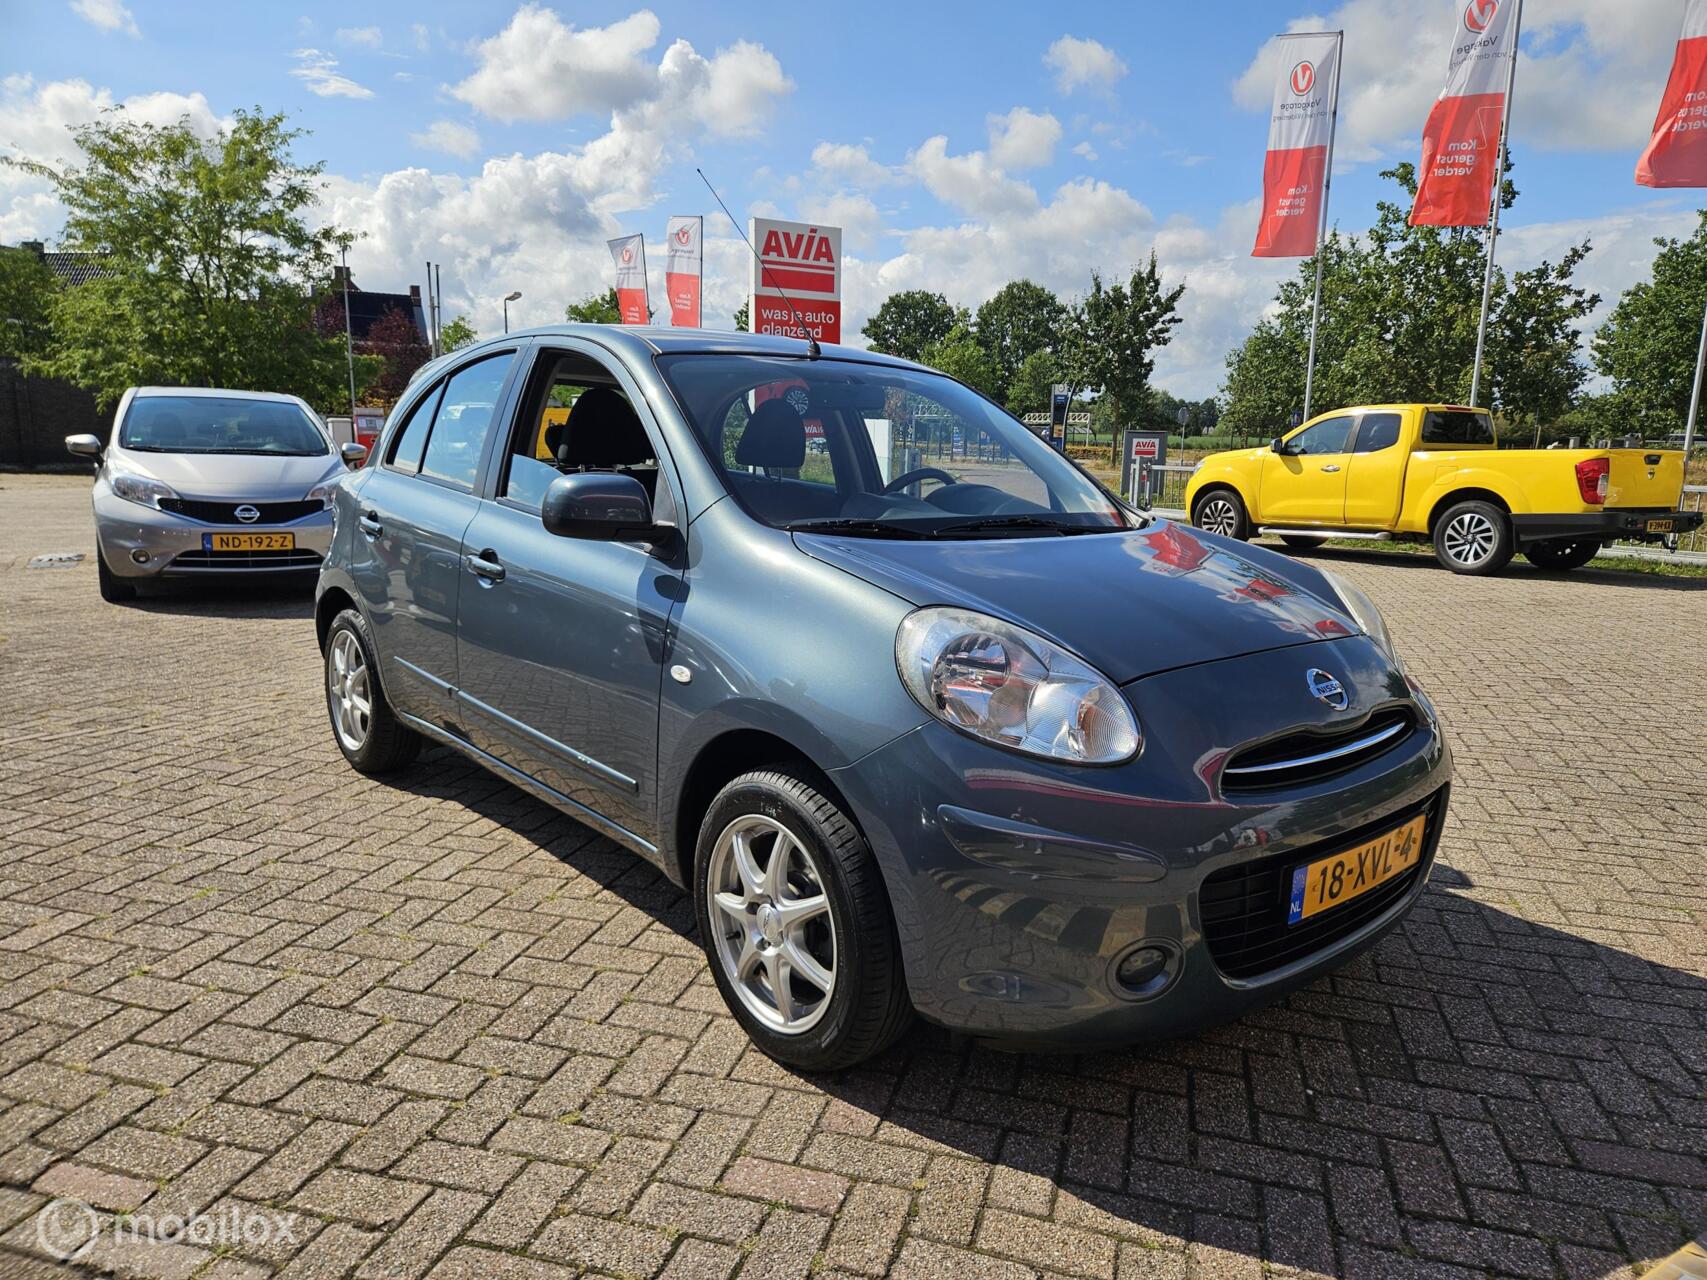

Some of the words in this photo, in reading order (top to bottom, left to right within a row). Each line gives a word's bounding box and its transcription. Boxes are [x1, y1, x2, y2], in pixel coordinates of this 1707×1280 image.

[762, 228, 835, 263] AVIA
[762, 309, 788, 320] was
[790, 310, 803, 324] je
[805, 311, 835, 323] auto
[762, 322, 822, 338] glanzend
[1135, 440, 1156, 448] AVIA
[220, 536, 288, 548] ND-192-Z
[1319, 827, 1413, 904] 18-XVL-4
[1290, 901, 1301, 914] NL
